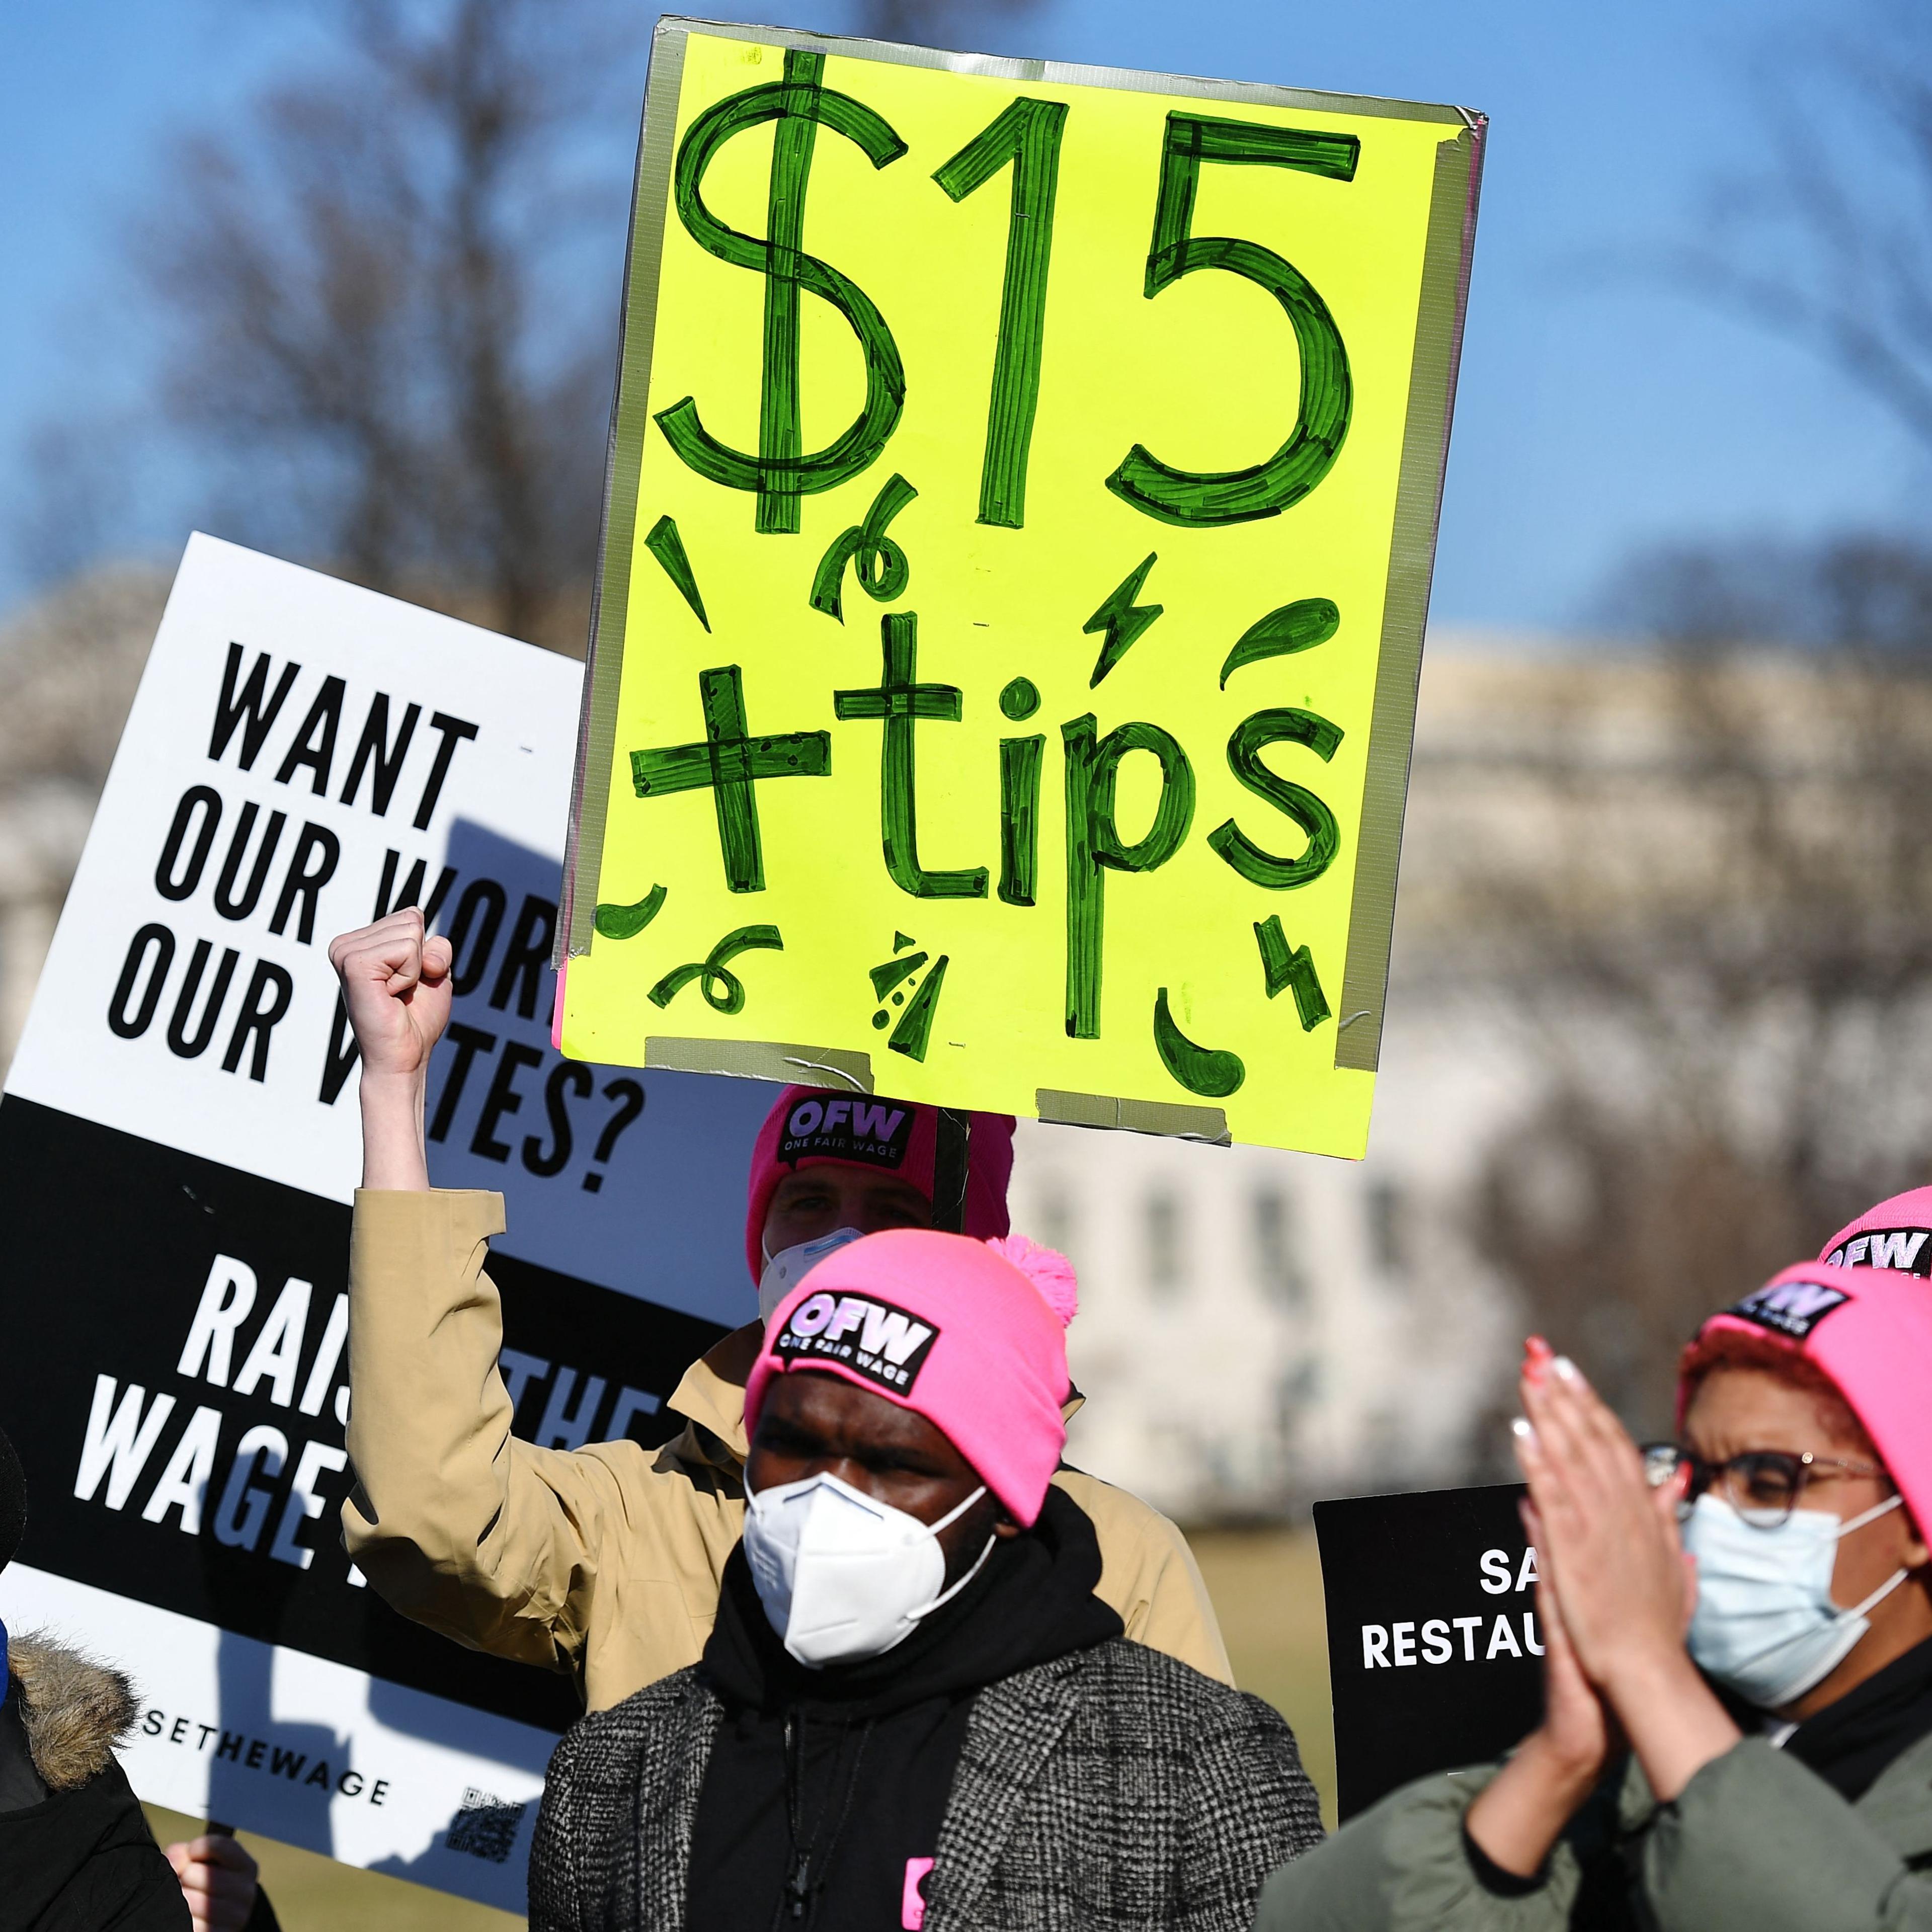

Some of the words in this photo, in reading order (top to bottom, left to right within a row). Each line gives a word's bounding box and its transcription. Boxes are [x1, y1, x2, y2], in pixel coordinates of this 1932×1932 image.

[654, 47, 1360, 534] $15
[208, 640, 480, 831] WANT
[154, 785, 340, 945] OUR
[373, 848, 560, 1027] WOR
[107, 923, 293, 1084] OUR
[319, 985, 645, 1193] VTES?
[784, 1138, 809, 1151] ONE
[814, 1137, 846, 1149] FAIR
[853, 1140, 897, 1158] WAGE
[789, 1100, 905, 1142] OFW
[177, 1253, 351, 1427] RAI
[779, 1333, 812, 1350] ONE
[814, 1338, 852, 1358] FAIR
[856, 1350, 910, 1386] WAGE
[790, 1293, 933, 1366] OFW
[73, 1373, 348, 1570] WAGE
